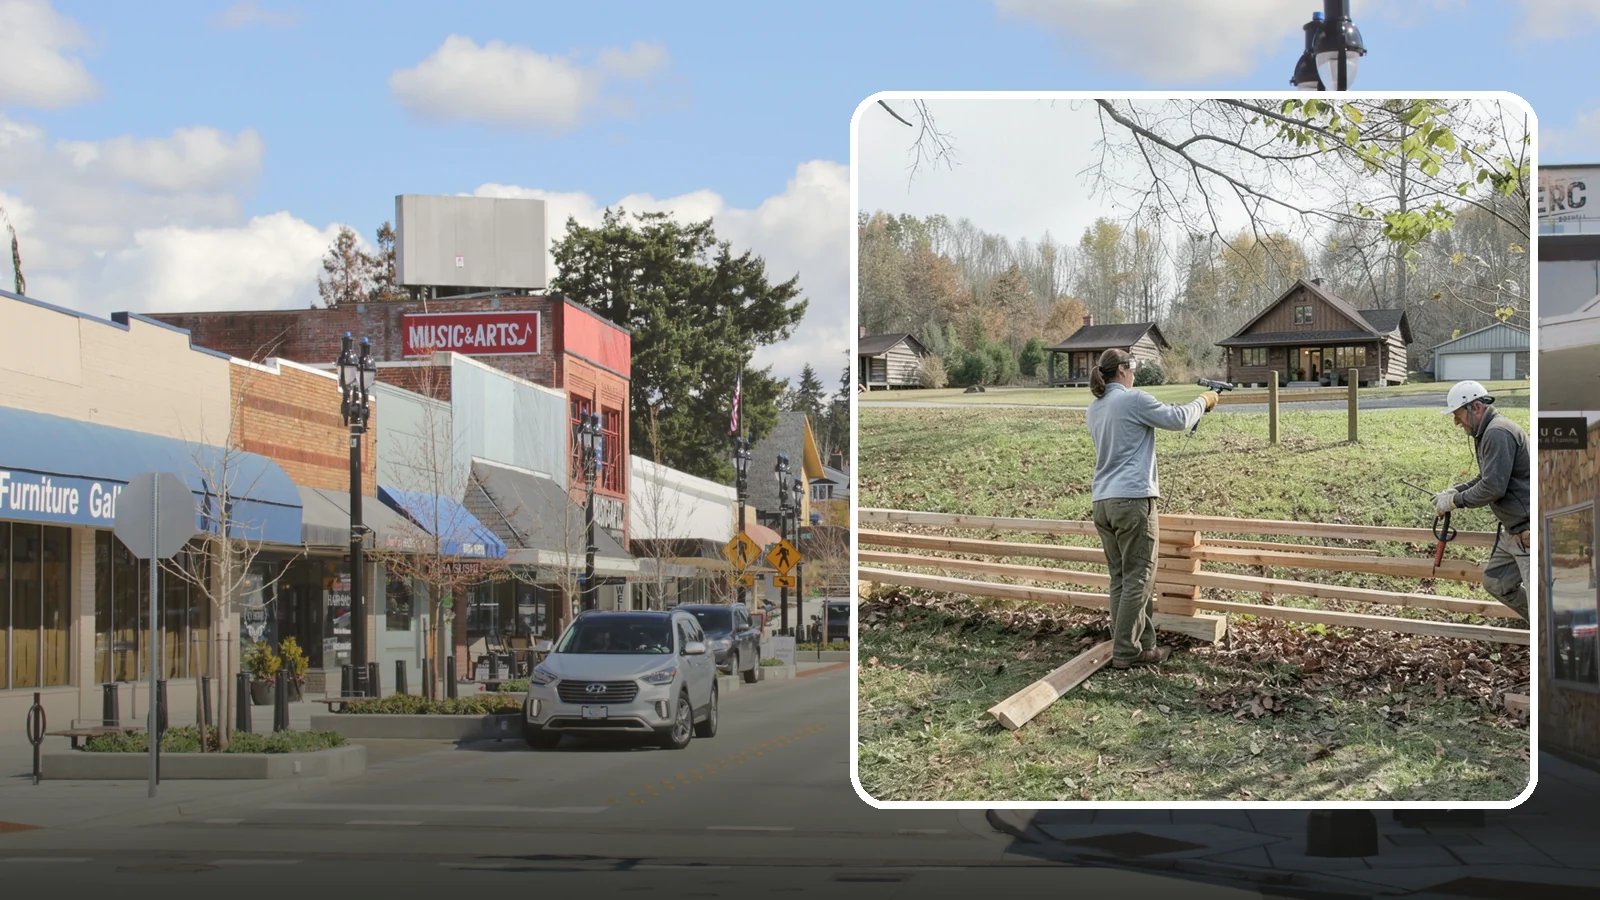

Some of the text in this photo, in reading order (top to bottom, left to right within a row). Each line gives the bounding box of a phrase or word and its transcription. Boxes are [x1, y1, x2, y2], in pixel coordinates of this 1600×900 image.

[1540, 427, 1577, 436] UGA
[0, 472, 122, 519] Furniture Gal
[453, 563, 479, 574] SUSHI
